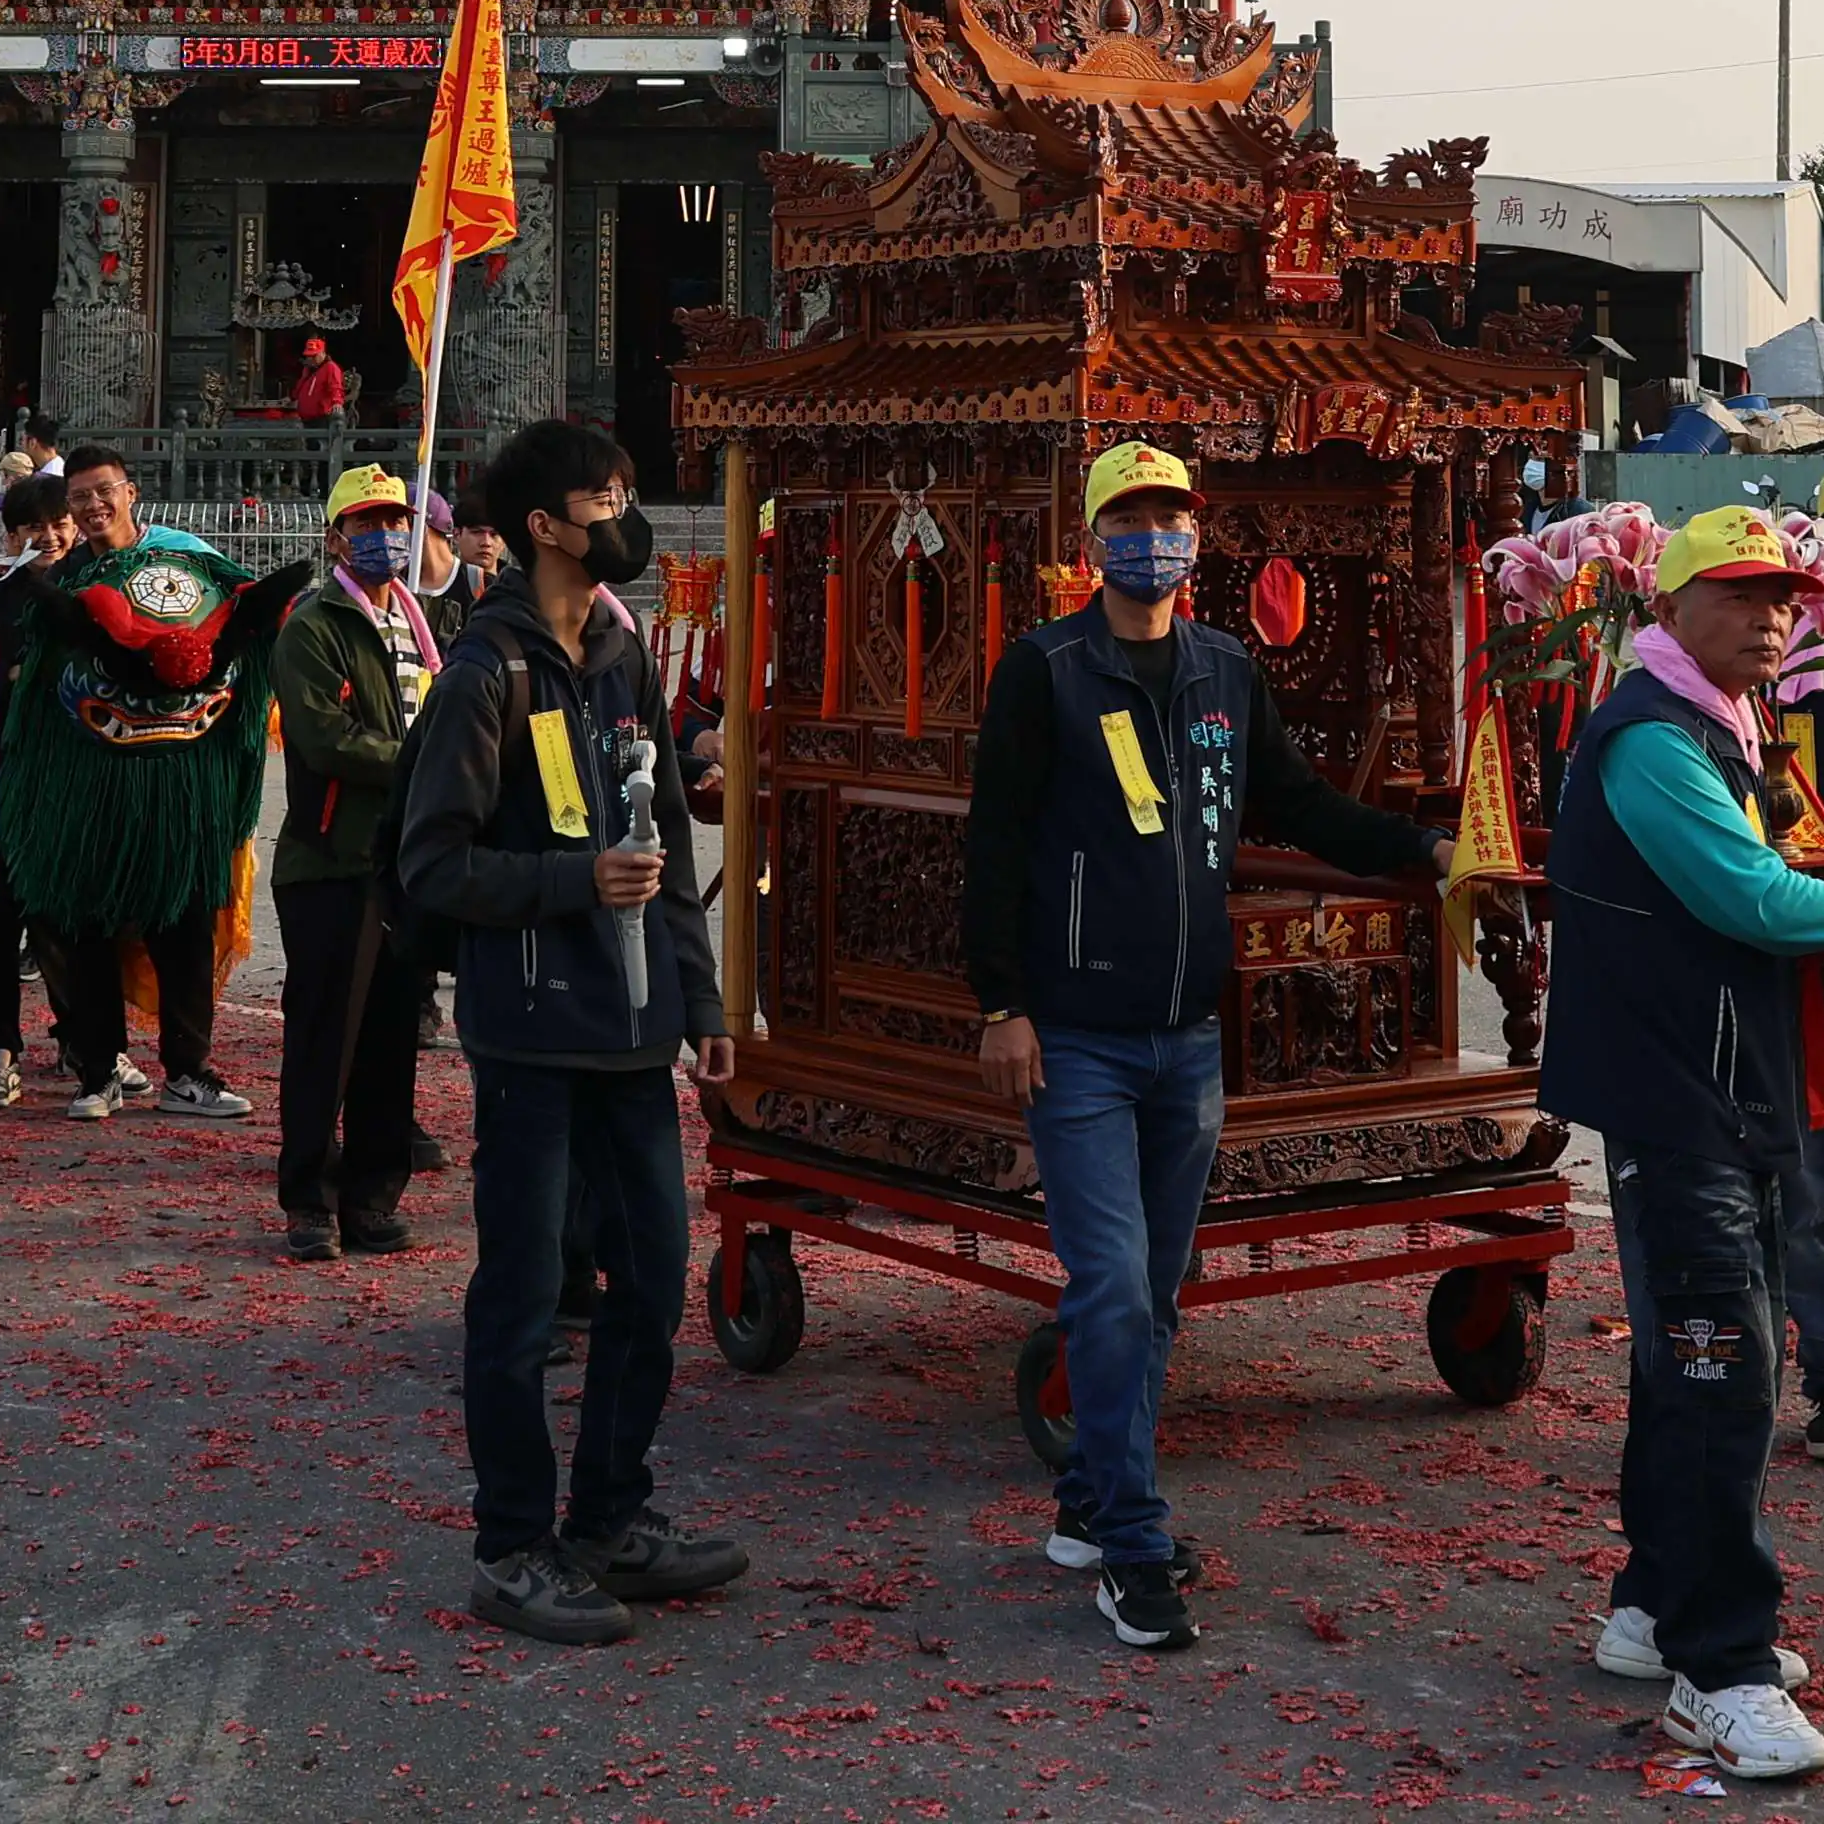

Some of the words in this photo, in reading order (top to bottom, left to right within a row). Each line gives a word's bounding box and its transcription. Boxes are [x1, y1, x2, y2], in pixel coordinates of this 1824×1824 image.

[1496, 195, 1612, 241] 成功廟
[1678, 1685, 1738, 1740] GUCCI
